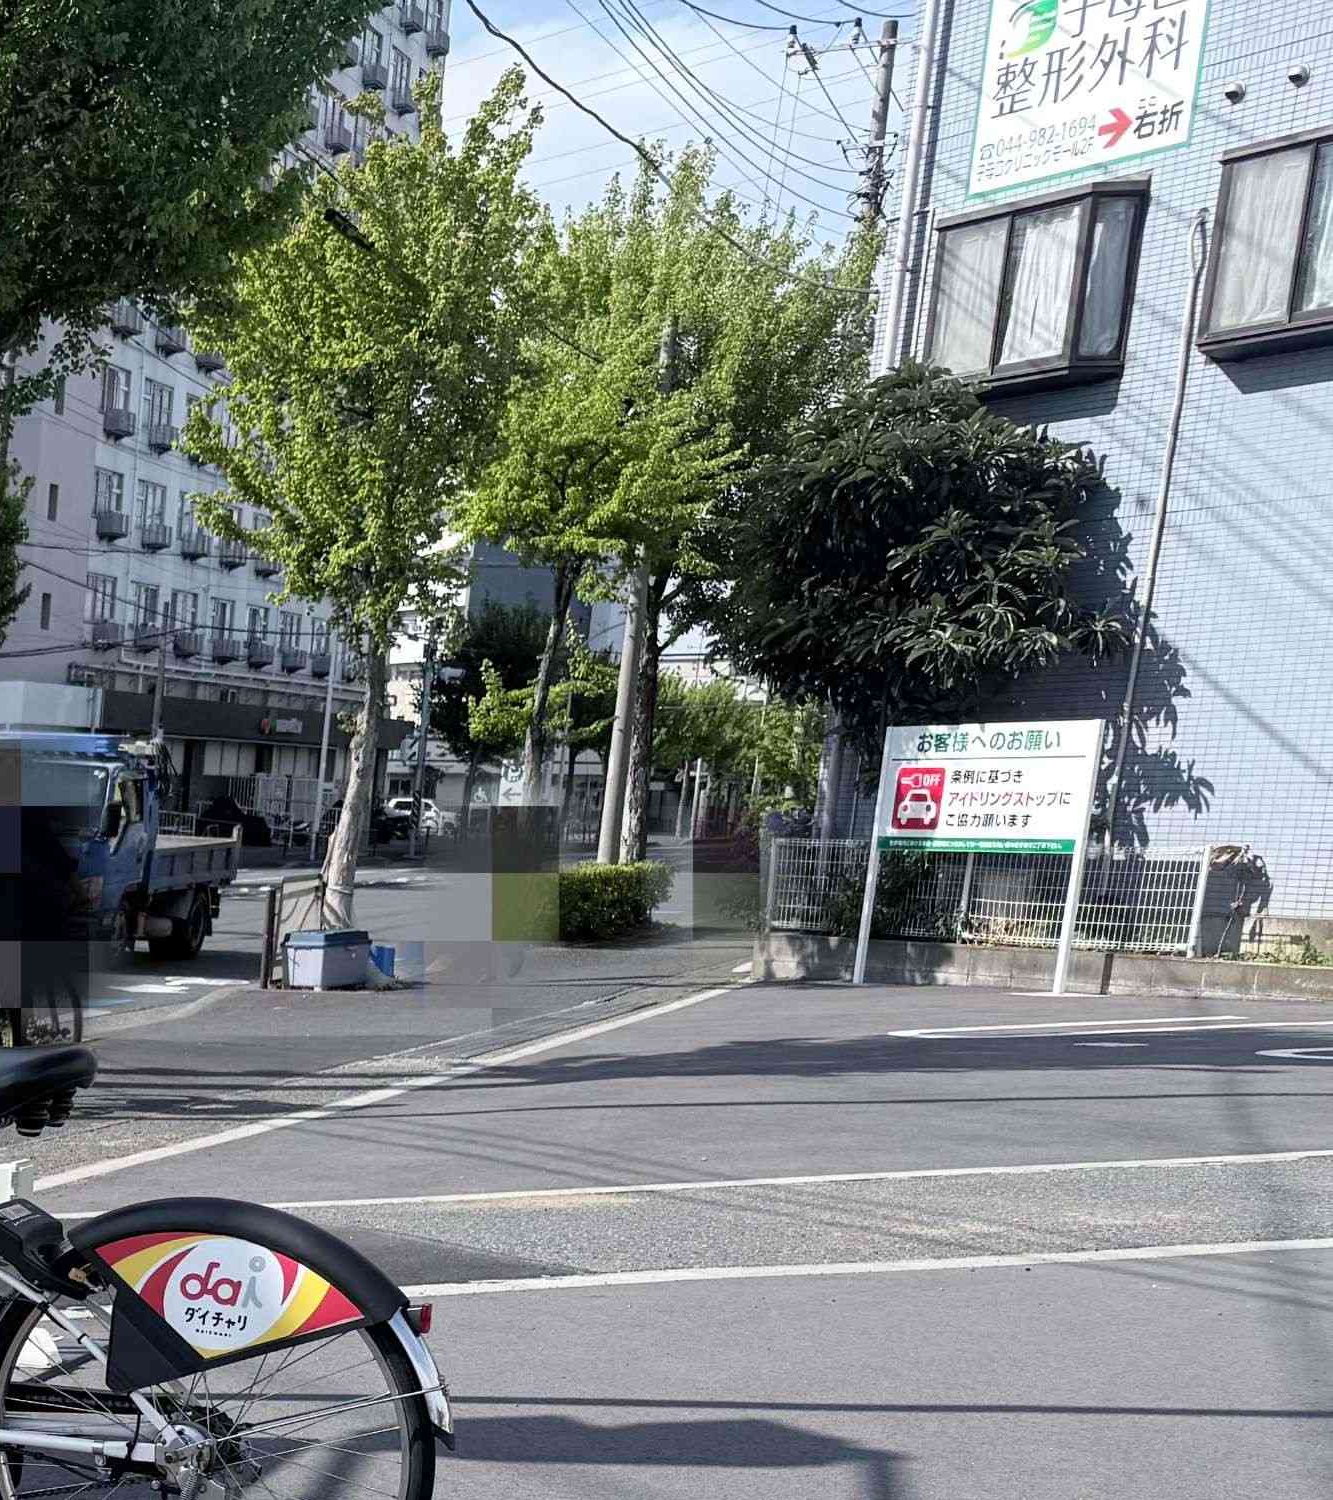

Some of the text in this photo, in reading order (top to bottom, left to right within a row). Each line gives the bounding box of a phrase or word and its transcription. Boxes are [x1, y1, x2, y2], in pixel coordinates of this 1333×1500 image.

[990, 9, 1190, 119] 整形外科
[1133, 99, 1185, 140] 右折
[917, 730, 1061, 753] お客様へのお願い
[923, 774, 942, 786] OFF
[950, 769, 1023, 784] 条例に基づき
[947, 791, 1073, 807] アイドリングストップに
[180, 1256, 262, 1308] dai
[184, 1306, 248, 1331] ダイチャリ
